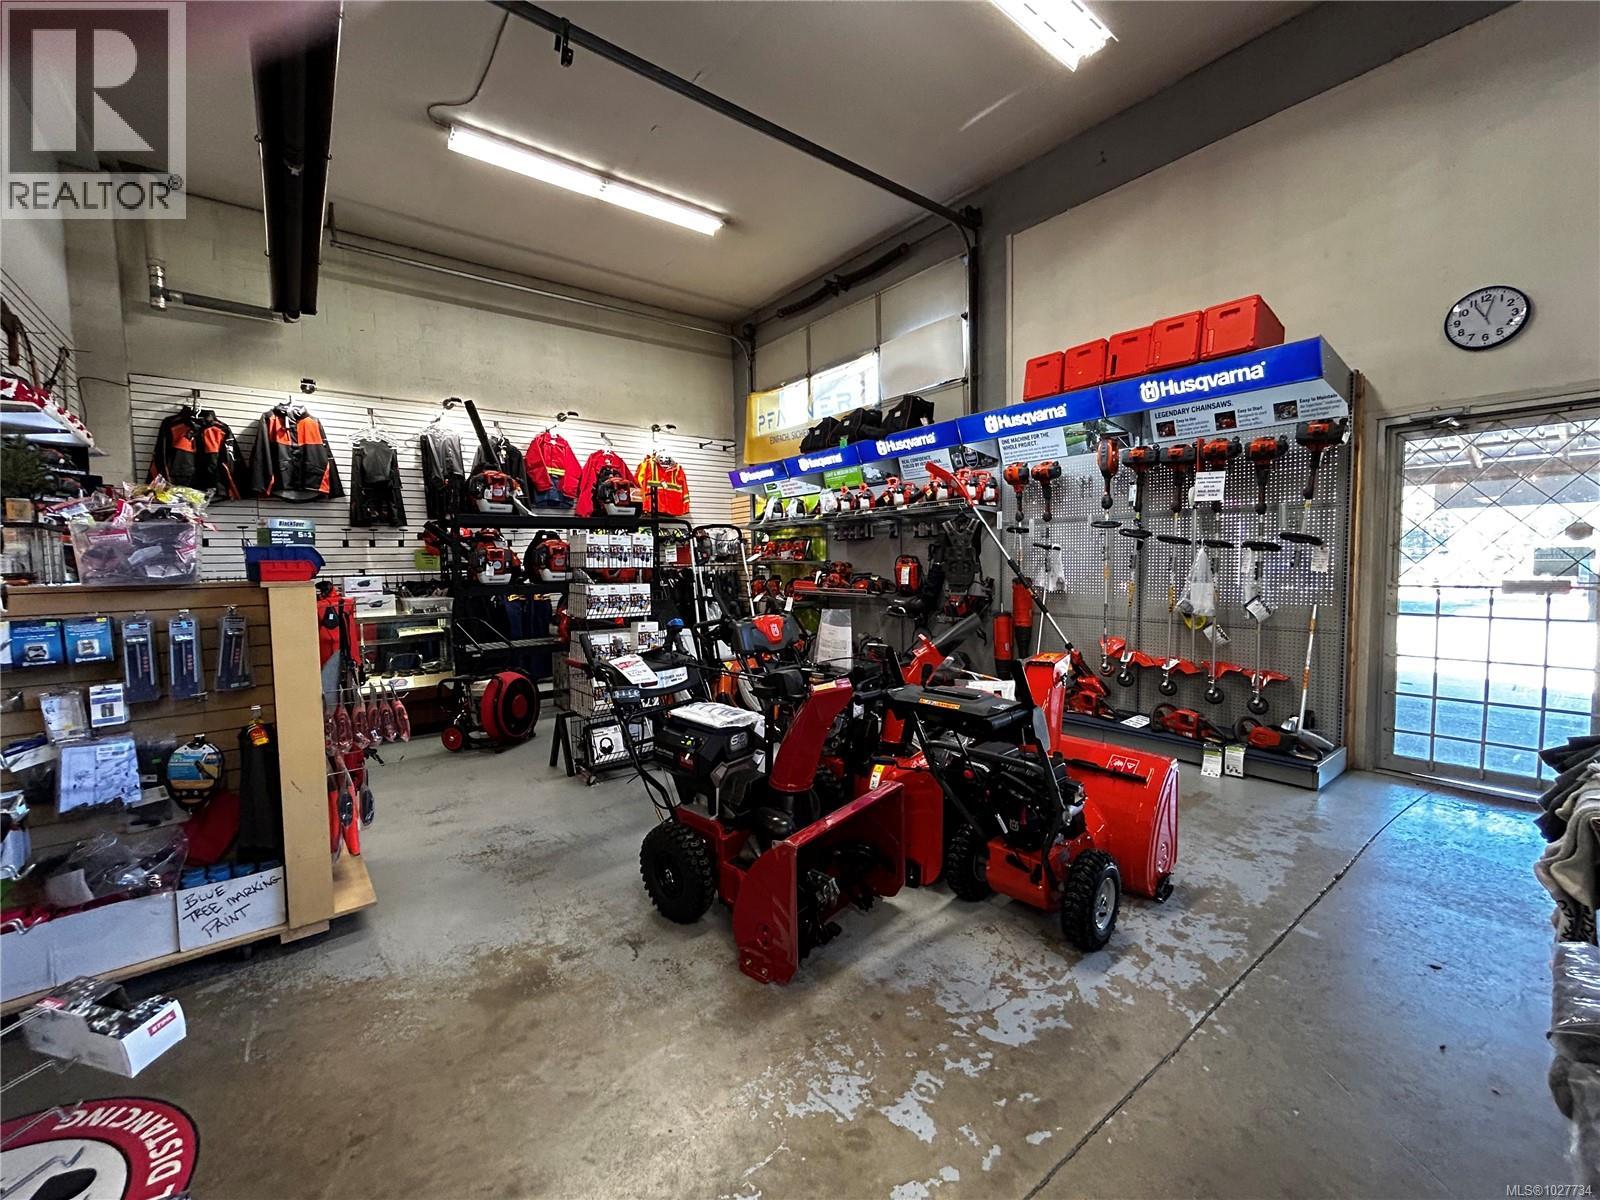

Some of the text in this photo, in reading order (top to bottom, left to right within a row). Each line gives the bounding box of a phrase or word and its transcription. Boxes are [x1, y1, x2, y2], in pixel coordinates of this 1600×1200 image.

[1481, 294, 1492, 303] 12
[1507, 298, 1515, 307] 2
[1458, 309, 1469, 317] 10
[1511, 307, 1519, 316] 3
[1453, 320, 1461, 328] 9
[1457, 328, 1465, 336] 8
[1496, 327, 1504, 336] 5
[1468, 333, 1475, 342] 7
[1481, 333, 1489, 341] 6
[1160, 362, 1266, 397] Husqvarna
[999, 404, 1067, 427] Husqvarna
[1154, 408, 1190, 419] LEGENDARY
[887, 432, 936, 453] Husqvarna
[1010, 435, 1030, 443] MACHINE
[183, 884, 228, 911] BLUE
[182, 902, 223, 923] TREE
[52, 1106, 184, 1186] DISTANCING
